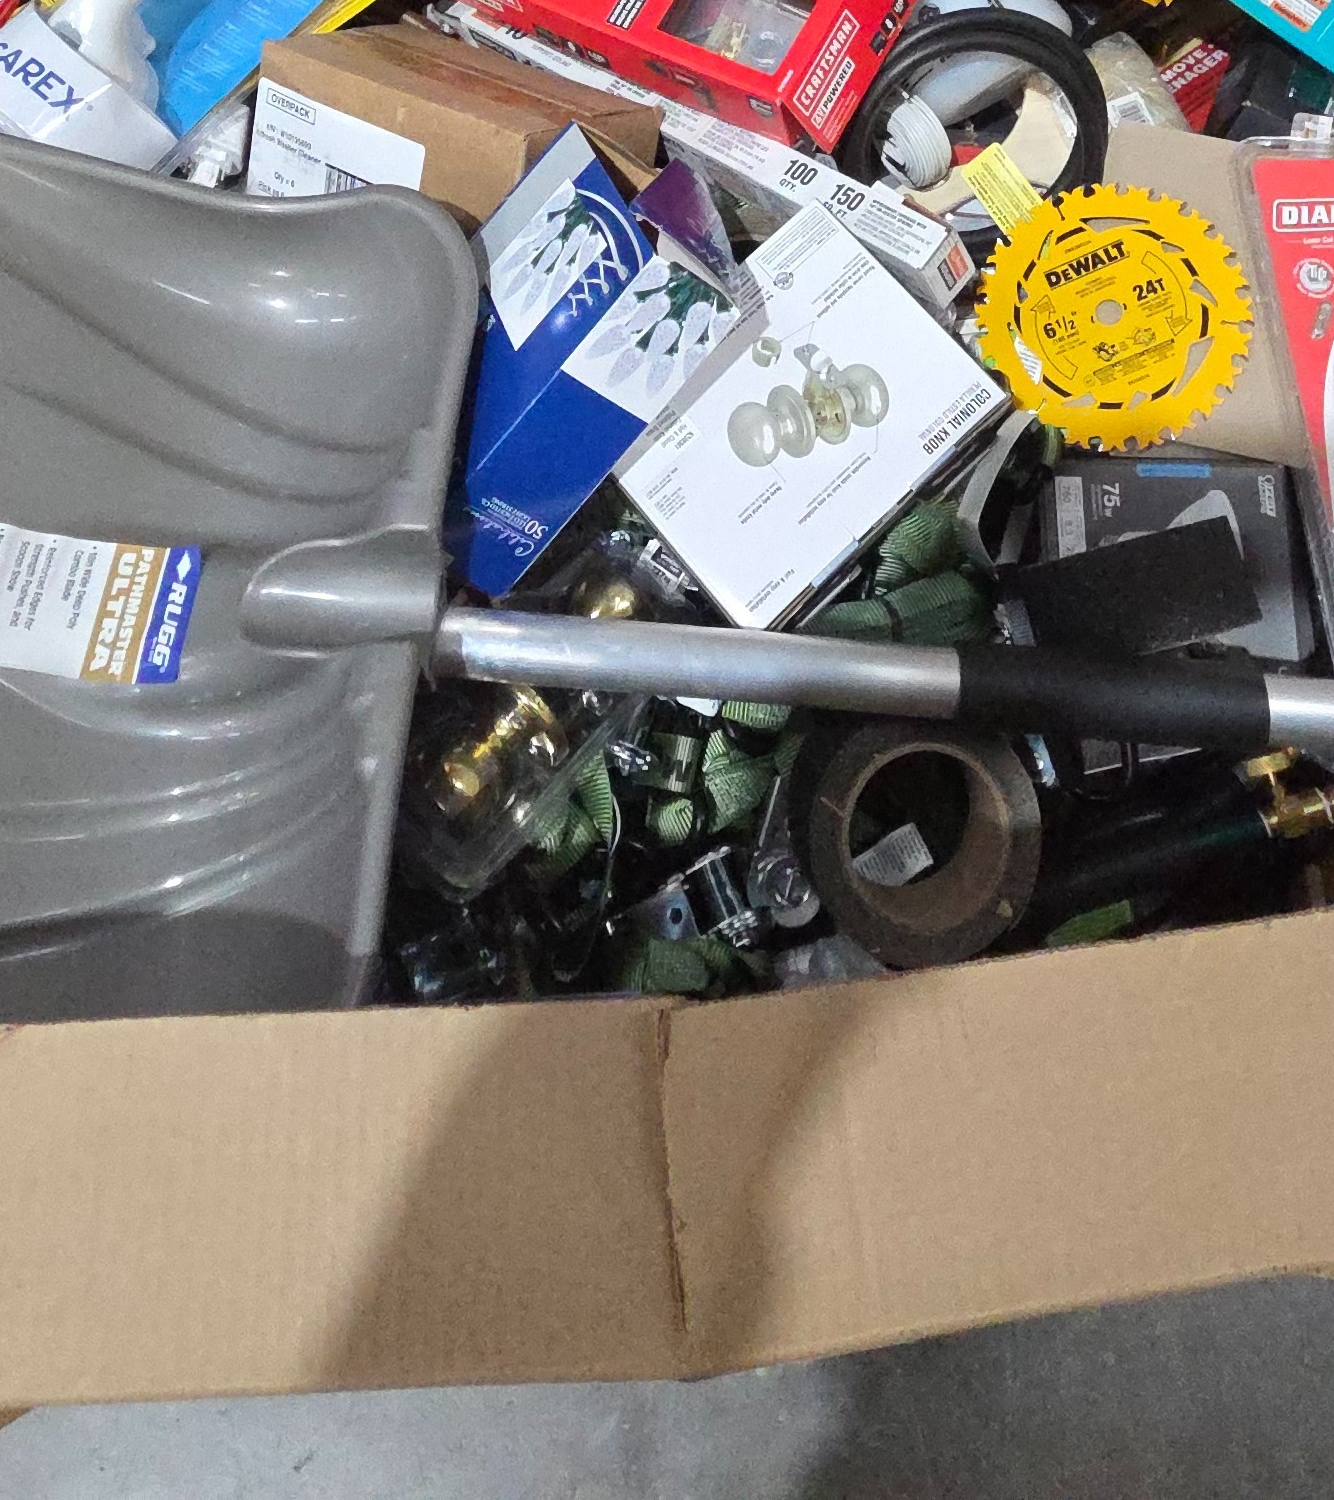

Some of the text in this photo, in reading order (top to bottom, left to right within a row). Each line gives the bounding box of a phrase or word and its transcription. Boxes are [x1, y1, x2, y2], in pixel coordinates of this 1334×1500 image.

[799, 17, 855, 108] CRAFTSMAN
[821, 59, 854, 111] POWERED
[270, 91, 313, 122] OVERPACK
[779, 177, 797, 194] QTY.
[783, 158, 867, 212] 100 150
[1043, 240, 1128, 291] DEWALT
[1132, 277, 1165, 301] 24T
[1043, 321, 1057, 340] 6
[921, 385, 992, 456] COLONIAL KNOB
[522, 517, 549, 541] 50
[89, 552, 139, 673] ULTRA
[106, 548, 156, 678] PATHMASTER
[152, 581, 189, 669] RUGG
